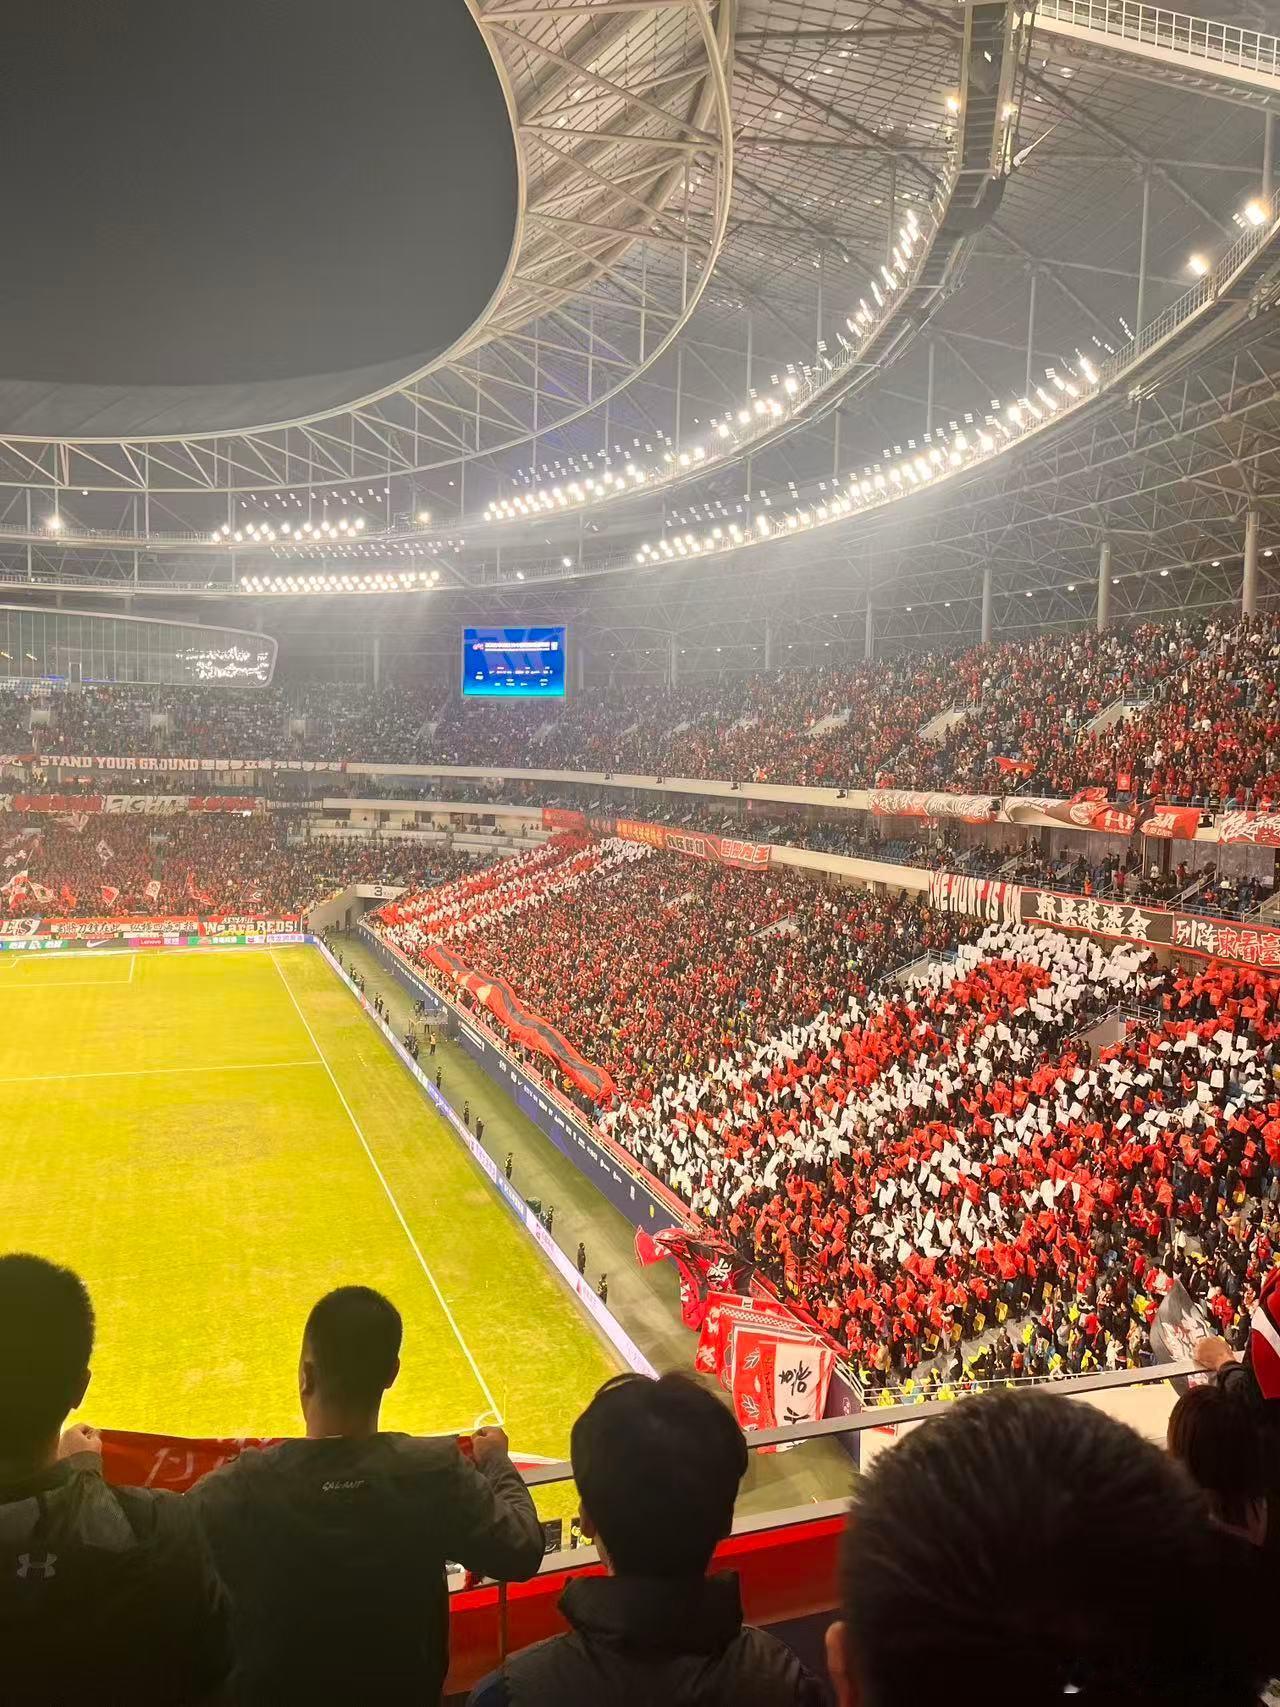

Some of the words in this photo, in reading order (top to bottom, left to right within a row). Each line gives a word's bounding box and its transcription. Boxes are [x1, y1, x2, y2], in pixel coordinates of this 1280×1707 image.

[40, 755, 92, 768] STAND
[96, 757, 137, 770] YOUR
[139, 758, 200, 771] GROUND
[374, 886, 383, 897] 3
[986, 880, 1001, 921] IS
[202, 921, 225, 935] We
[228, 923, 254, 933] are
[257, 920, 298, 934] REDS!
